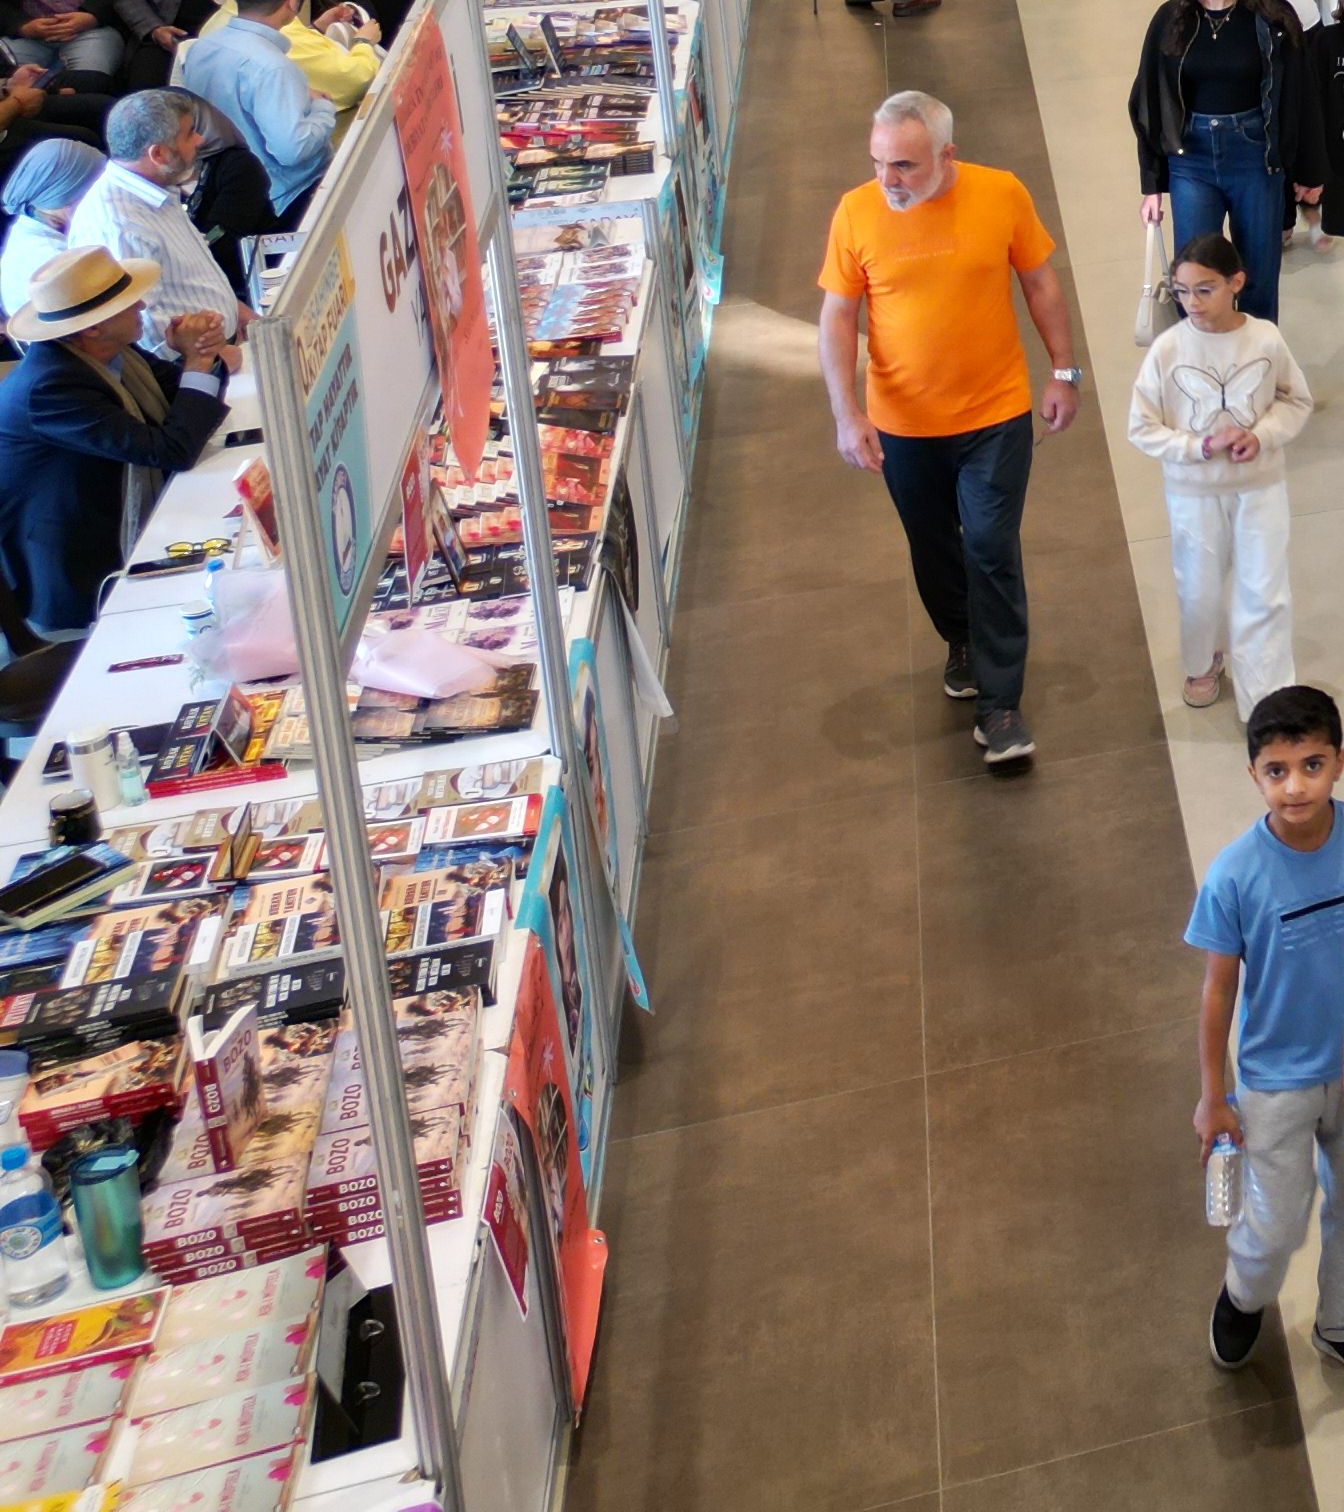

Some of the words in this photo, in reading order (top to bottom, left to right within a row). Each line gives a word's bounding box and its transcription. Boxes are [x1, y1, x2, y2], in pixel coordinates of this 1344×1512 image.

[223, 1029, 252, 1074] BOZO
[340, 1083, 362, 1122] BOZO
[326, 1137, 350, 1176] BOZO
[339, 1177, 377, 1194] BOZO
[167, 1188, 193, 1230] BOZO
[339, 1195, 376, 1212] BOZO
[176, 1229, 217, 1248] BOZO
[347, 1224, 384, 1241] BOZO
[185, 1243, 225, 1263] BOZO
[197, 1258, 237, 1278] BOZO
